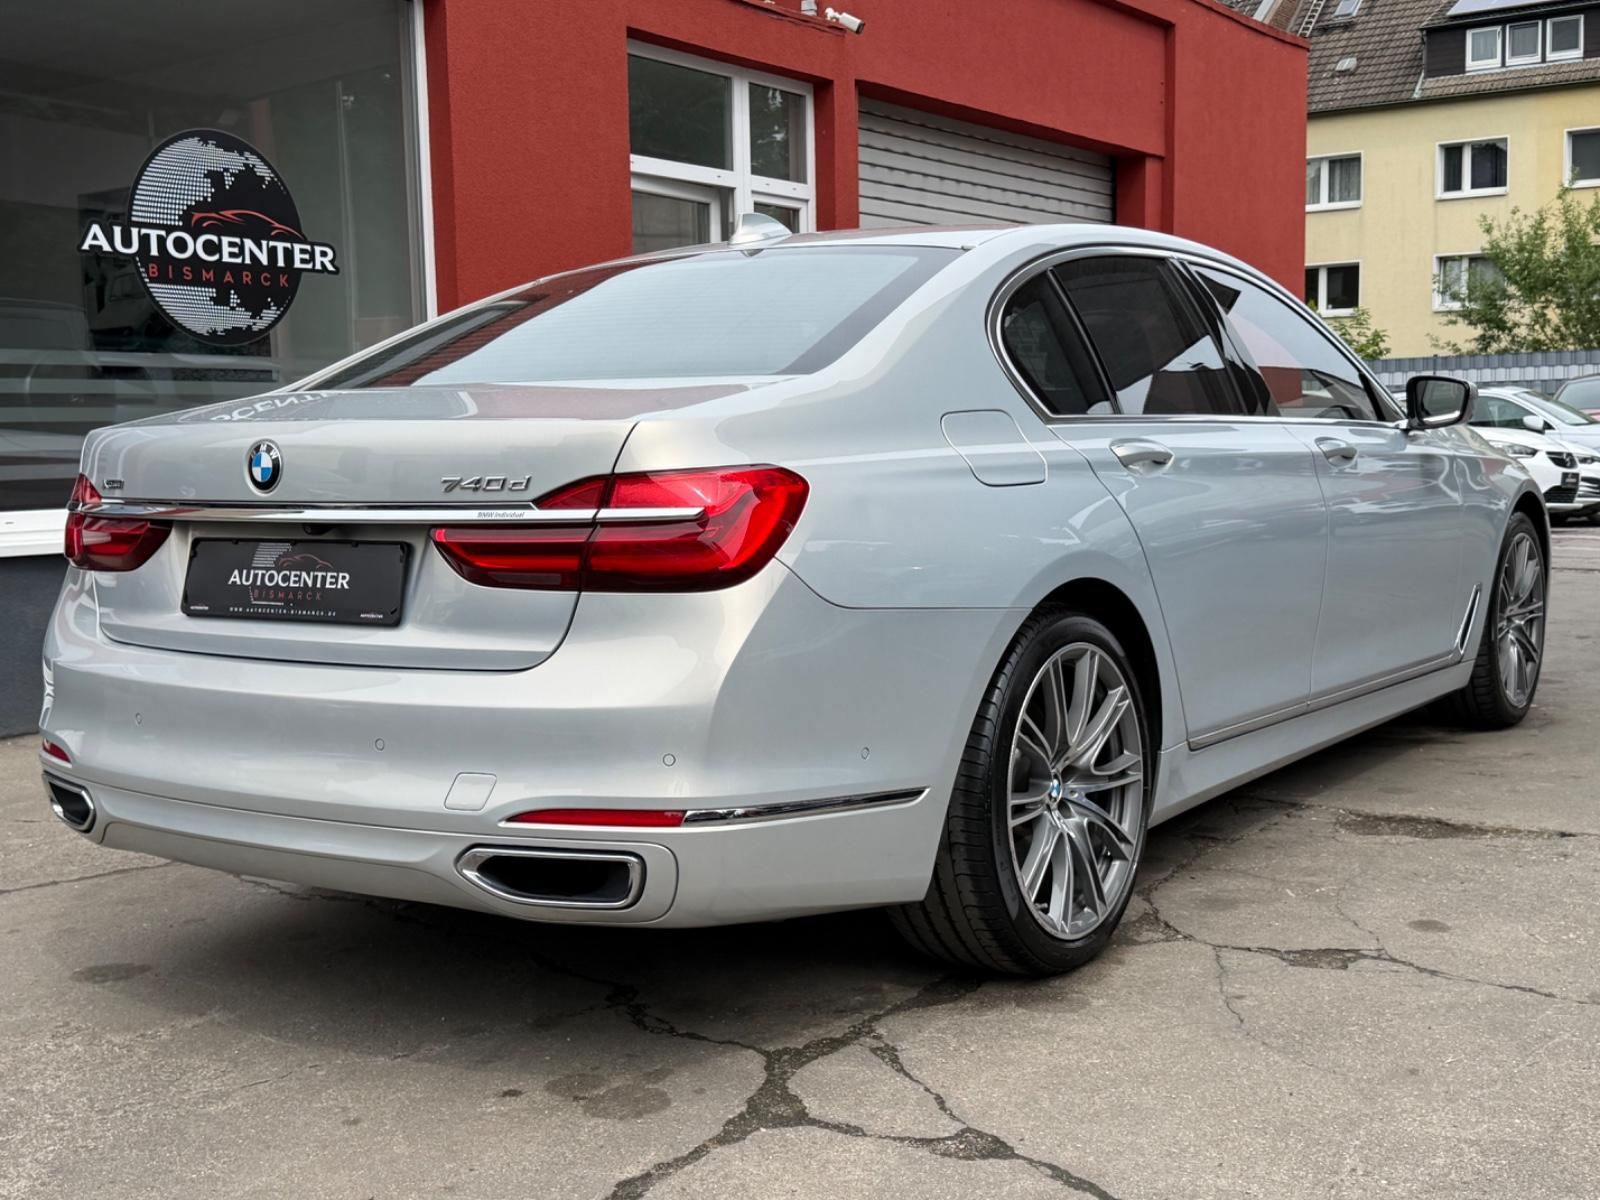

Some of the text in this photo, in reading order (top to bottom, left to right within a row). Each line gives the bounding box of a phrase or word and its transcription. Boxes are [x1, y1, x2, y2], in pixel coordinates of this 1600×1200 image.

[81, 223, 337, 272] AUTOCENTER
[148, 263, 290, 287] BISMARCK
[440, 475, 532, 493] 740d
[228, 569, 350, 589] AUTOCENTER
[253, 589, 322, 602] BISMARCK
